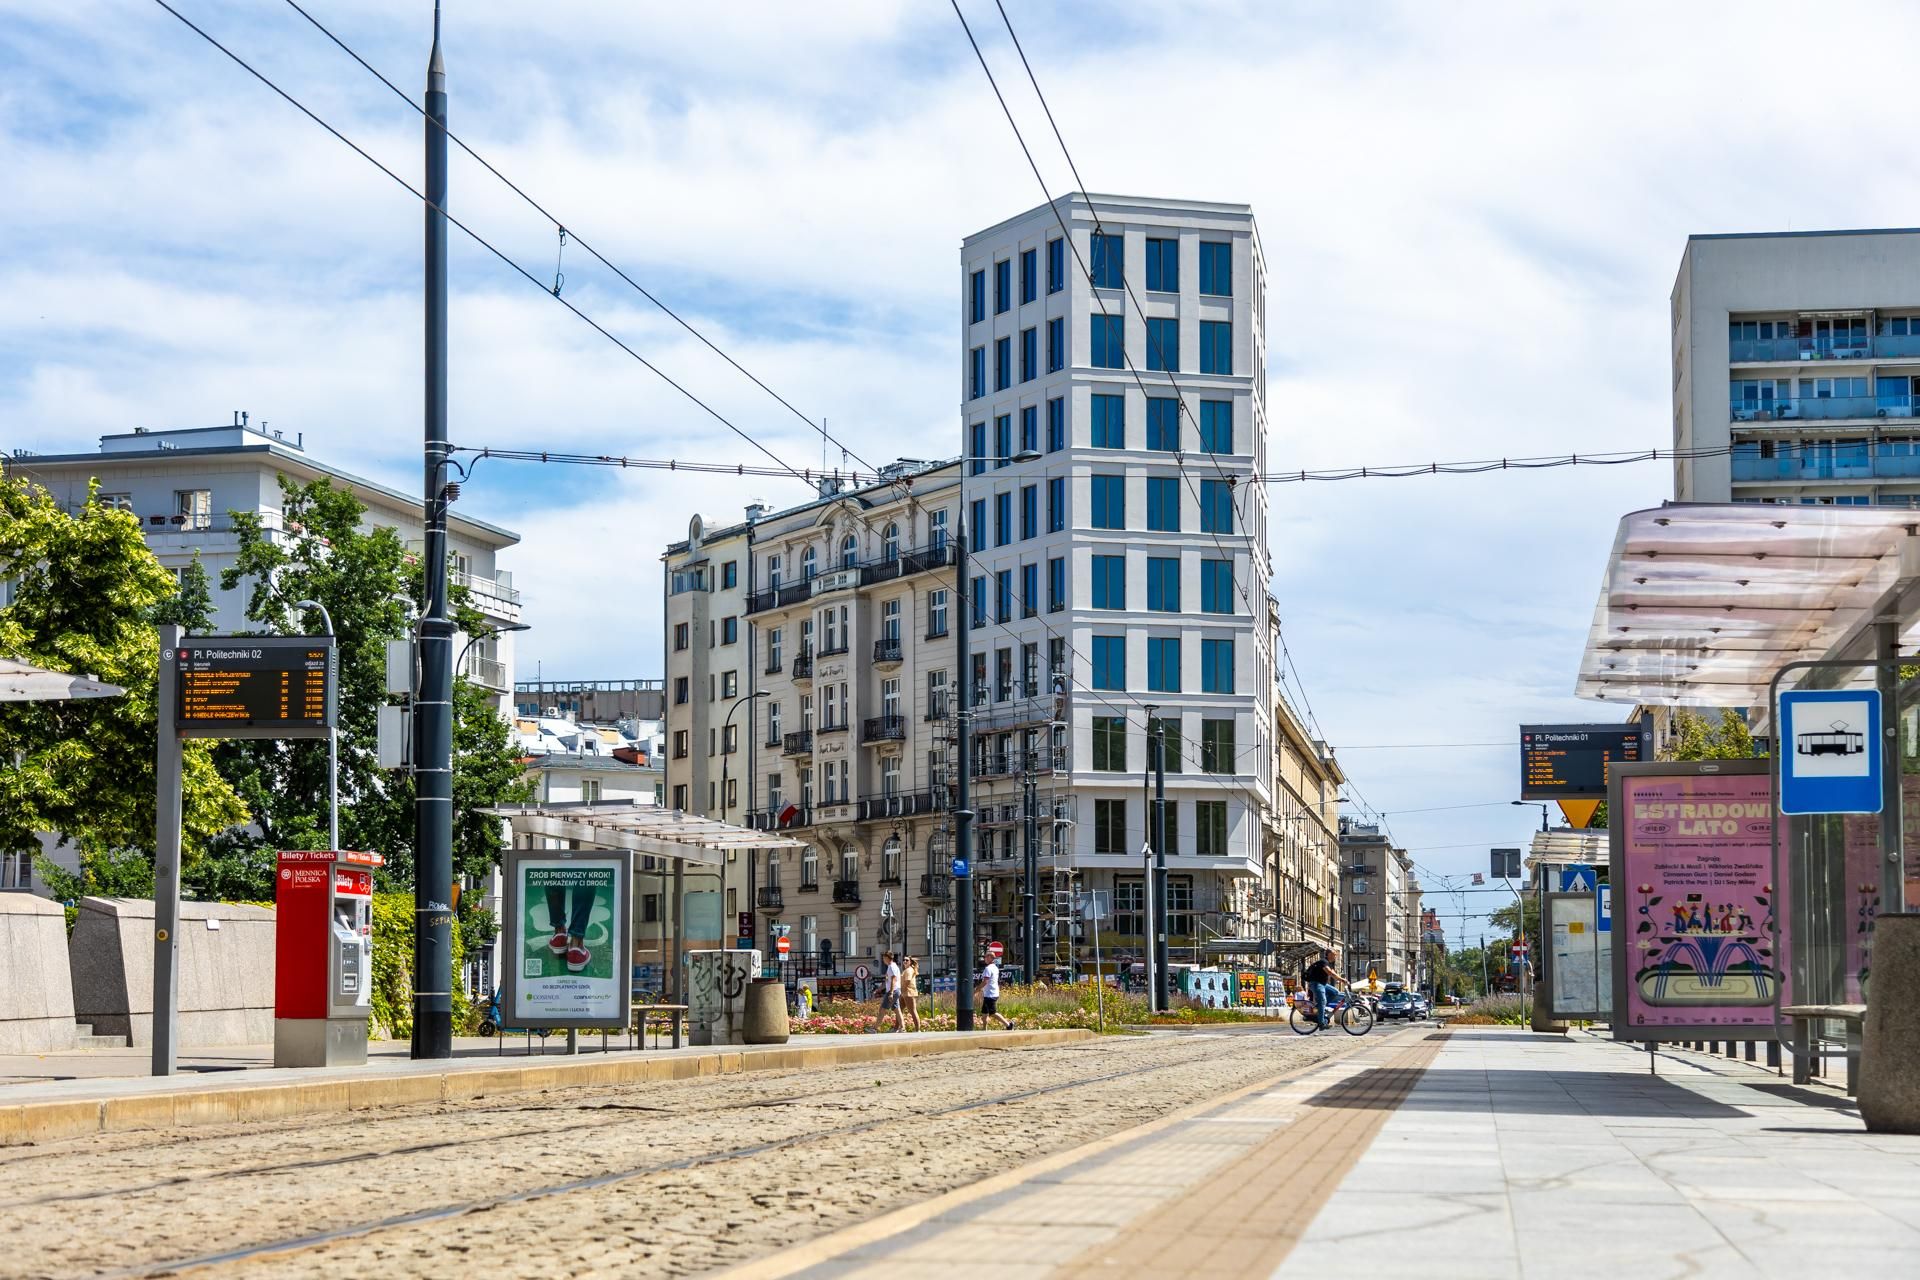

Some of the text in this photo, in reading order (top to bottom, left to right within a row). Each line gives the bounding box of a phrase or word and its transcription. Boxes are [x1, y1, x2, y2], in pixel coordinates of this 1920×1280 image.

[194, 649, 262, 659] Pl. Politechniki 02
[1545, 734, 1580, 742] Politechniki
[1678, 820, 1738, 836] LATO
[281, 852, 304, 861] Bilety
[529, 870, 611, 879] ZRÓB PIERWSZY KROK!
[337, 874, 353, 889] Bilety
